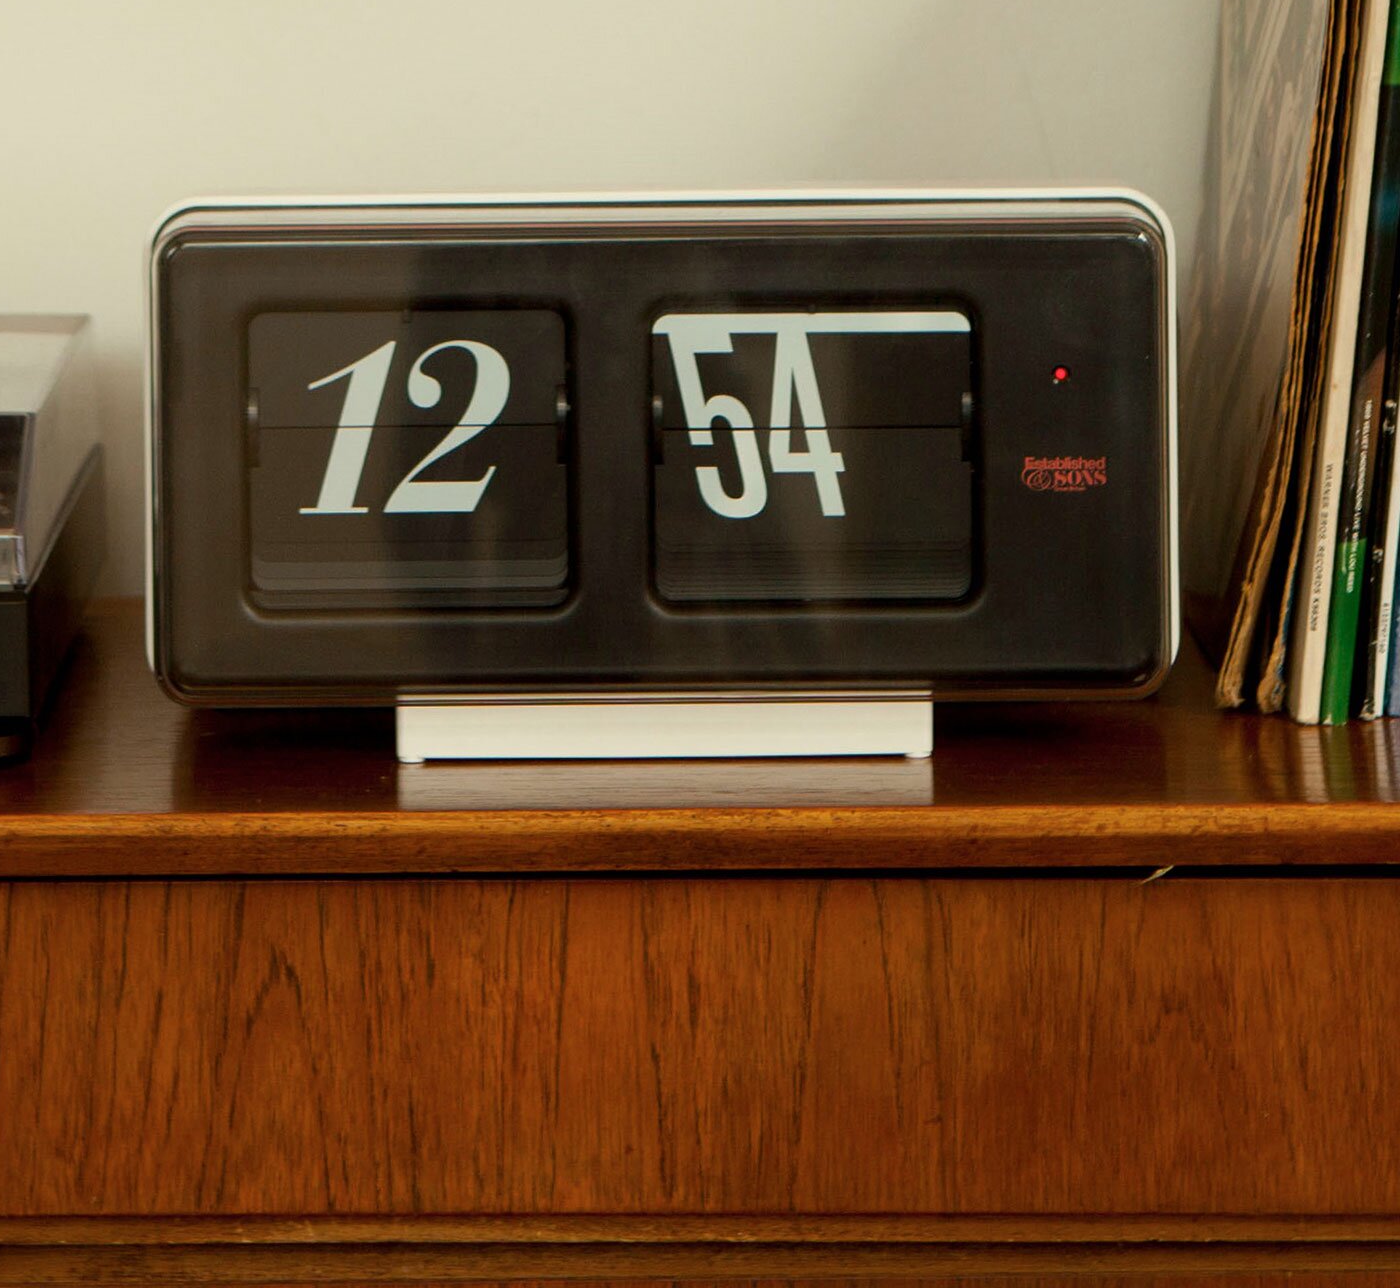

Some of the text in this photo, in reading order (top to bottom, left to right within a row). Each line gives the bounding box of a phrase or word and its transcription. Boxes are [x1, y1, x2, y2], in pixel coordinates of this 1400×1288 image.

[299, 339, 512, 514] 12
[666, 313, 846, 519] 54
[1360, 420, 1370, 449] VELVET
[1024, 456, 1107, 470] Established
[1053, 469, 1108, 486] SONS
[1321, 463, 1333, 508] WARNER
[1354, 450, 1367, 510] UNDERGROUND
[1352, 511, 1361, 530] LIVE
[1350, 531, 1359, 552] WITH
[1313, 545, 1325, 593] RECORDS
[1348, 553, 1357, 570] LOU
[1346, 571, 1355, 593] REED
